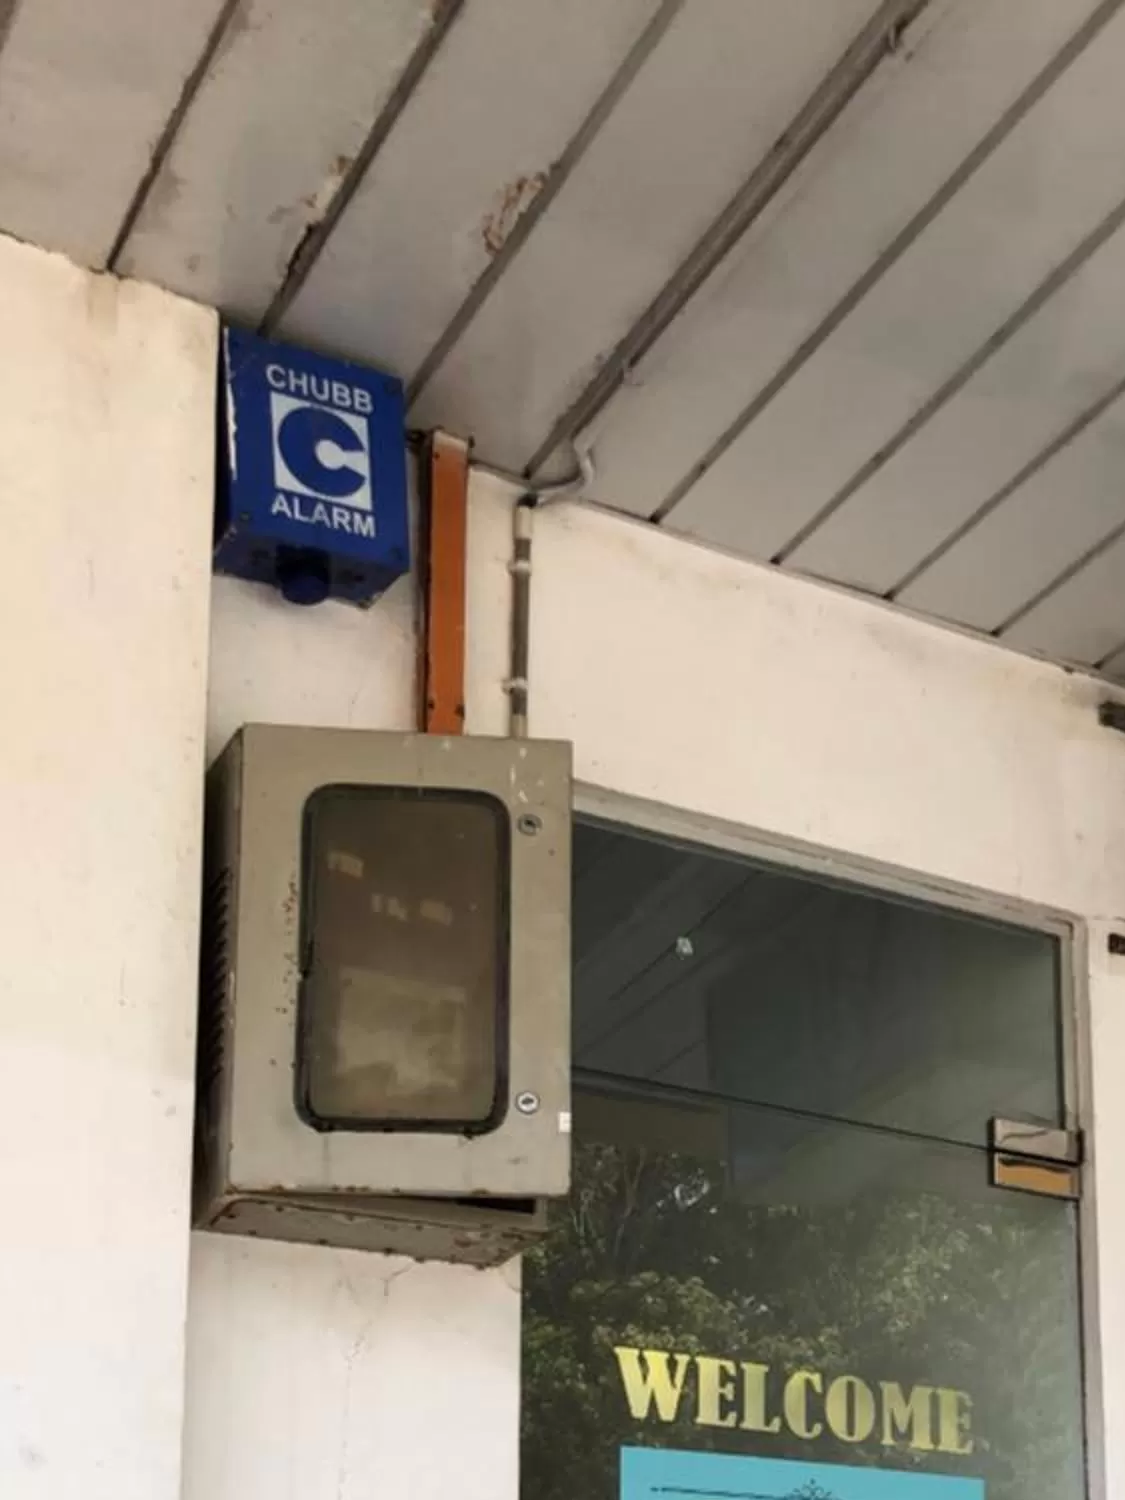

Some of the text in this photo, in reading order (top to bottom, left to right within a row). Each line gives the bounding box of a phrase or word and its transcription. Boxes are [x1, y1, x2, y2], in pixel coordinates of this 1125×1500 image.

[265, 363, 374, 415] CHUBB
[271, 493, 377, 539] ALARM
[614, 1346, 974, 1455] WELCOME
